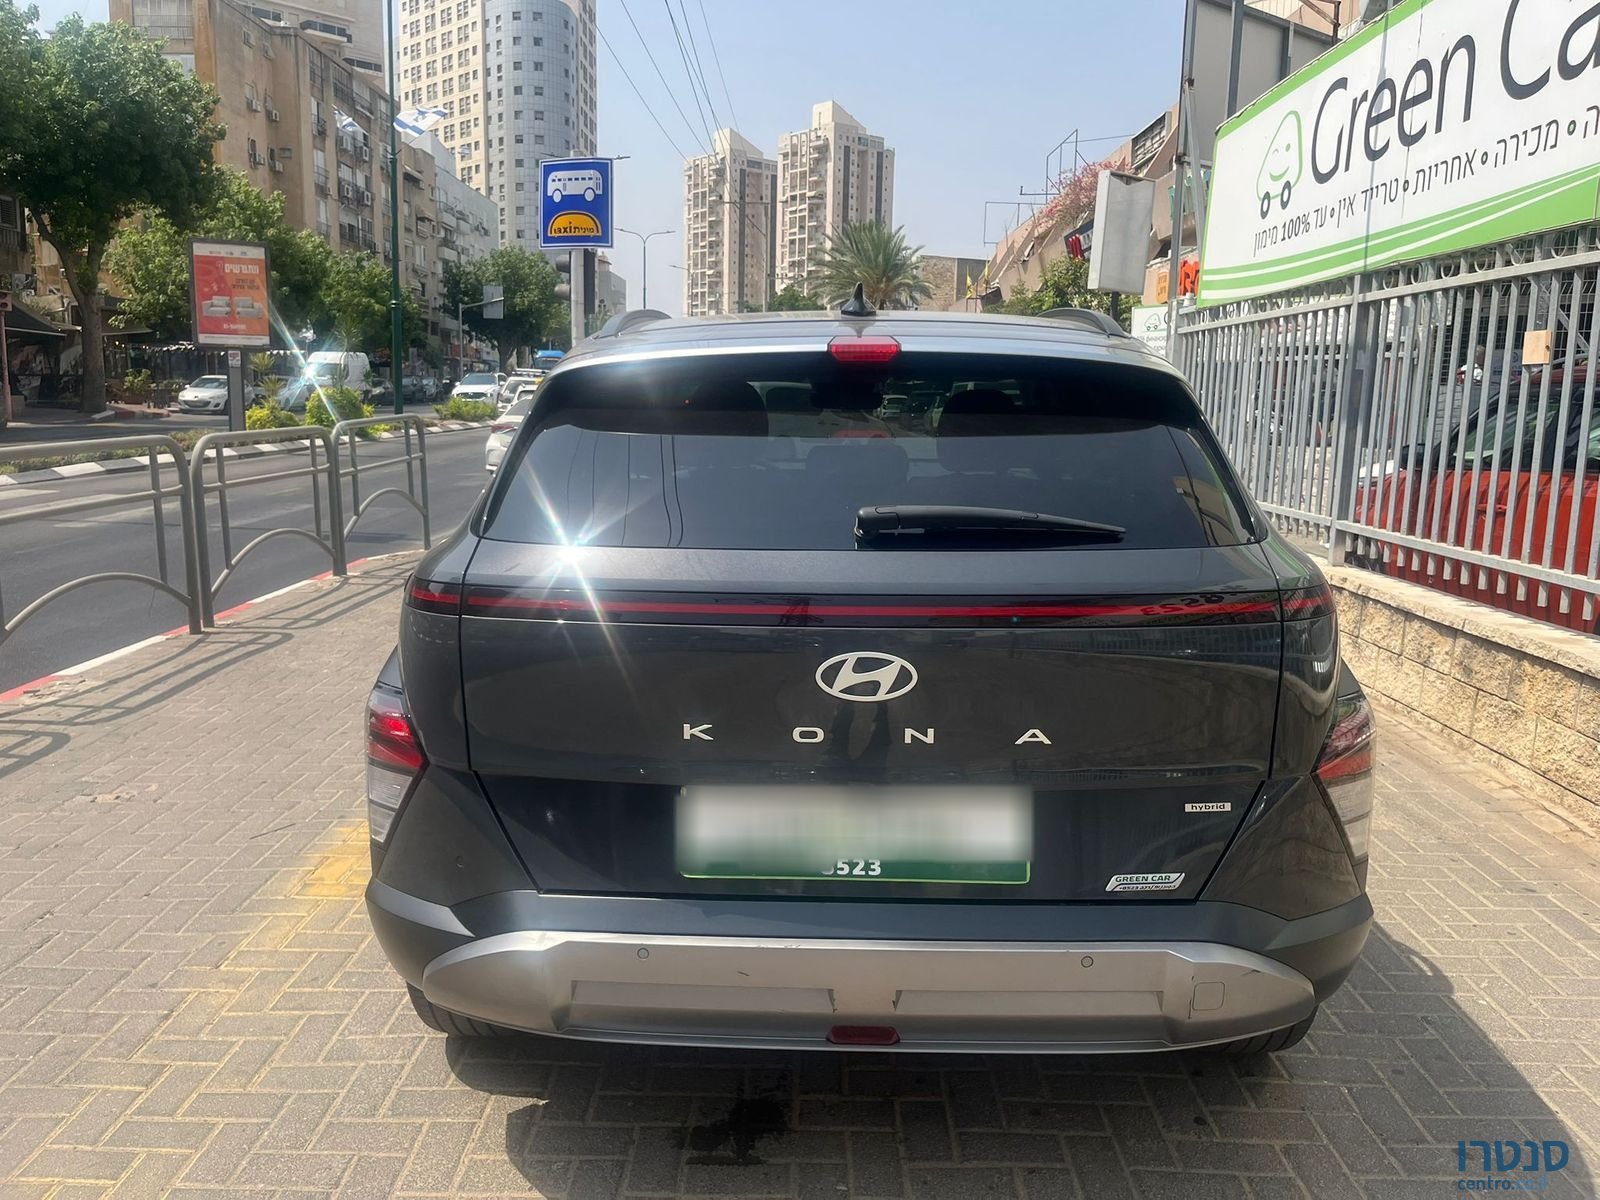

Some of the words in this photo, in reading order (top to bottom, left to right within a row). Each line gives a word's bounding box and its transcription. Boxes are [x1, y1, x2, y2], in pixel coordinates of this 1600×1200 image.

[1311, 34, 1476, 184] Green
[1494, 119, 1559, 168] מכירה
[1413, 148, 1477, 195] אחריות
[1337, 193, 1357, 228] אין
[1361, 178, 1398, 212] טרייד
[1281, 212, 1310, 242] 100%
[1313, 205, 1327, 229] עד
[1253, 225, 1278, 258] מימון
[683, 723, 1052, 745] KONA
[1191, 803, 1226, 811] hybrid
[1115, 875, 1149, 883] GREEN
[1151, 874, 1171, 882] CAR
